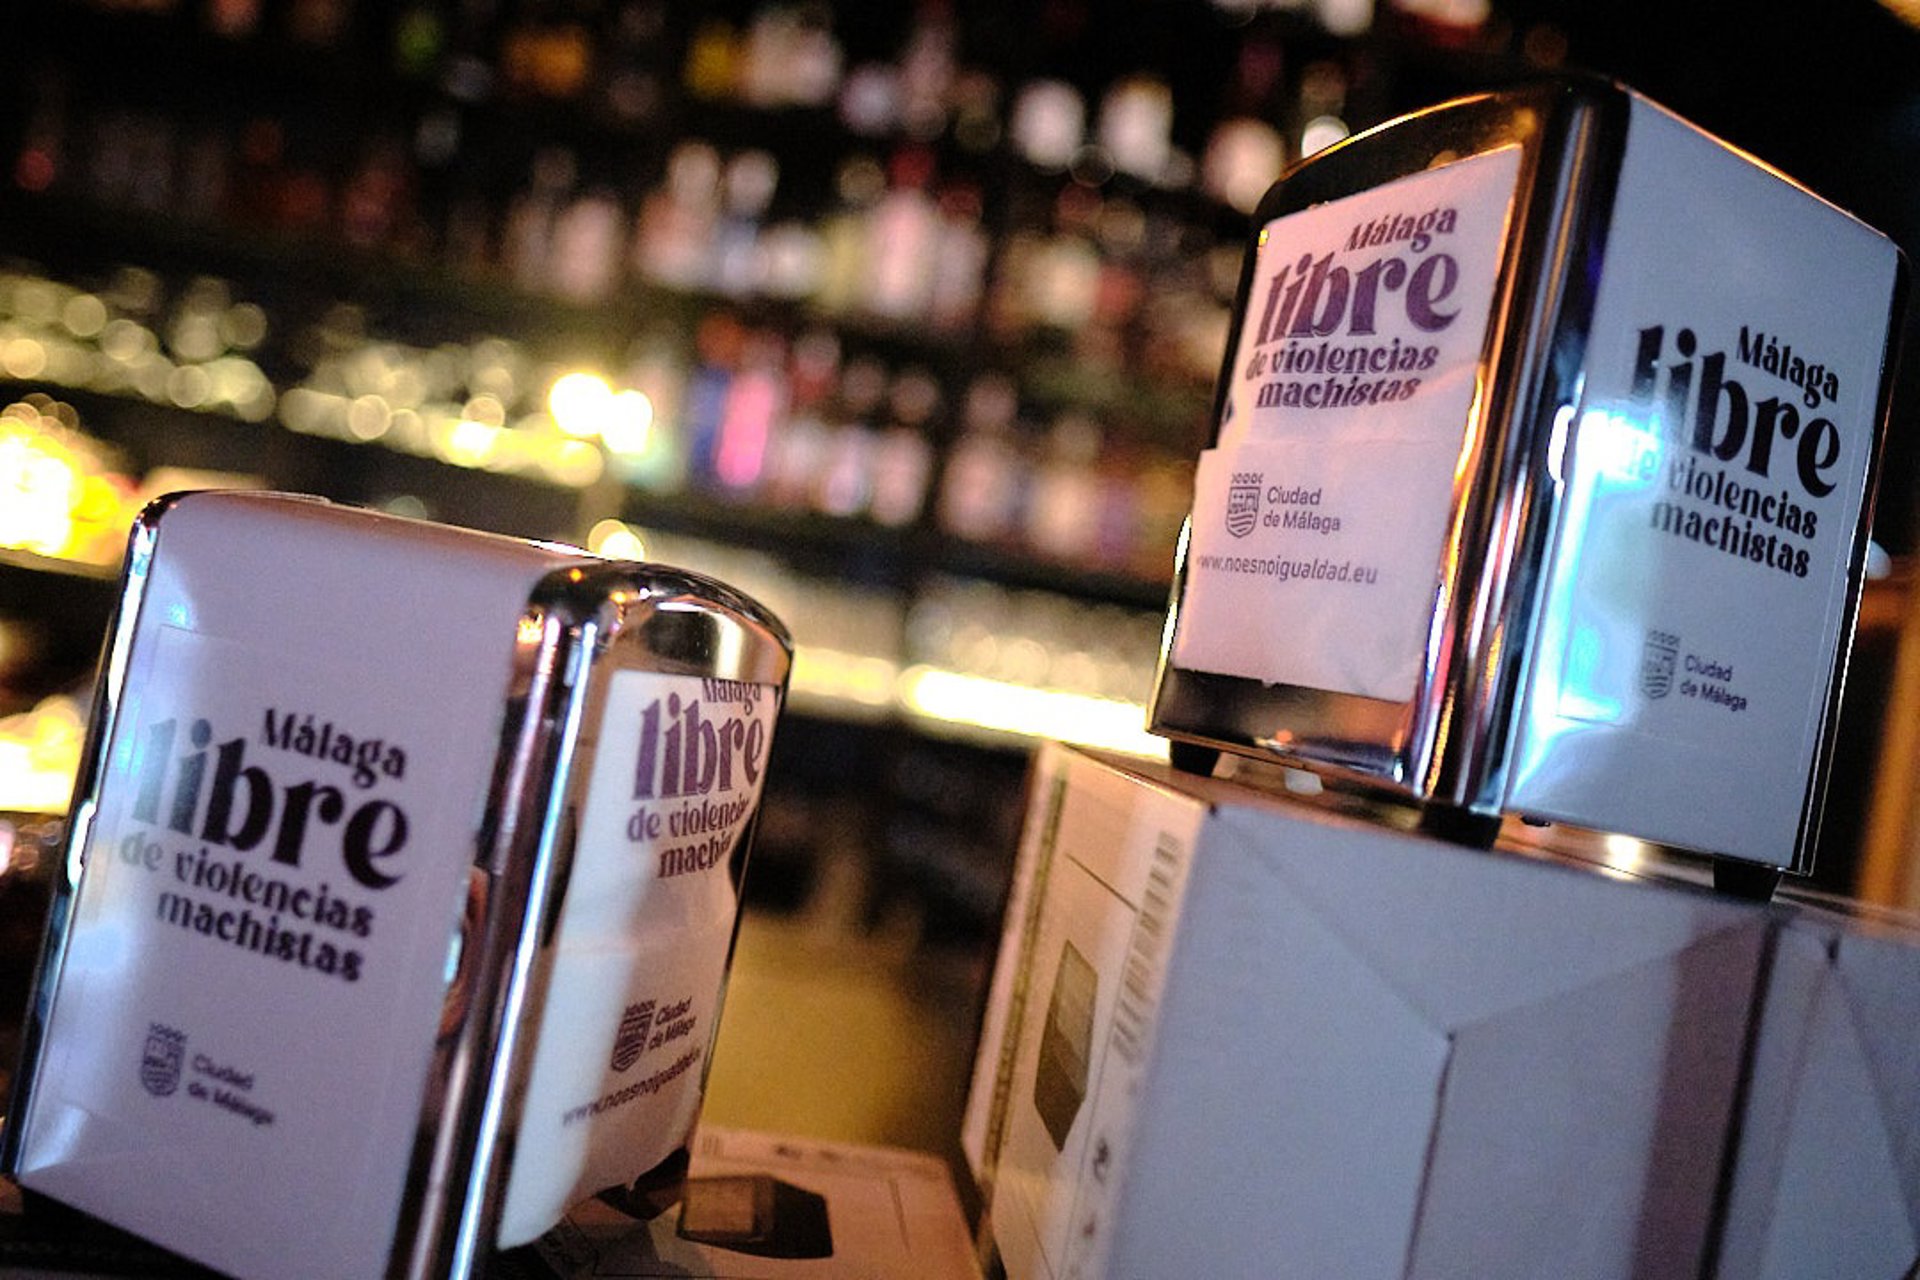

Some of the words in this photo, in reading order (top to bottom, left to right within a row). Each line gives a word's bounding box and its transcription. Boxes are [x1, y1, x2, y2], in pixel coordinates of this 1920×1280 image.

[1343, 207, 1458, 253] Málaga
[1255, 250, 1462, 348] libre
[1245, 350, 1268, 381] de
[1271, 337, 1440, 374] violencias
[1255, 376, 1422, 410] machistas
[1737, 324, 1840, 410] Málaga
[1630, 324, 1841, 499] libre
[1263, 510, 1279, 528] de
[1282, 510, 1342, 535] Málaga
[1266, 486, 1322, 506] Ciudad
[1650, 500, 1811, 579] machistas
[1679, 679, 1698, 697] de
[1701, 682, 1748, 712] Málaga
[1684, 653, 1734, 683] Ciudad
[264, 707, 407, 790] Málaga
[631, 691, 764, 801] libre
[130, 717, 411, 891] libre
[627, 807, 661, 843] de
[118, 830, 164, 872] de
[174, 846, 375, 939] violencias
[156, 891, 366, 983] machistas
